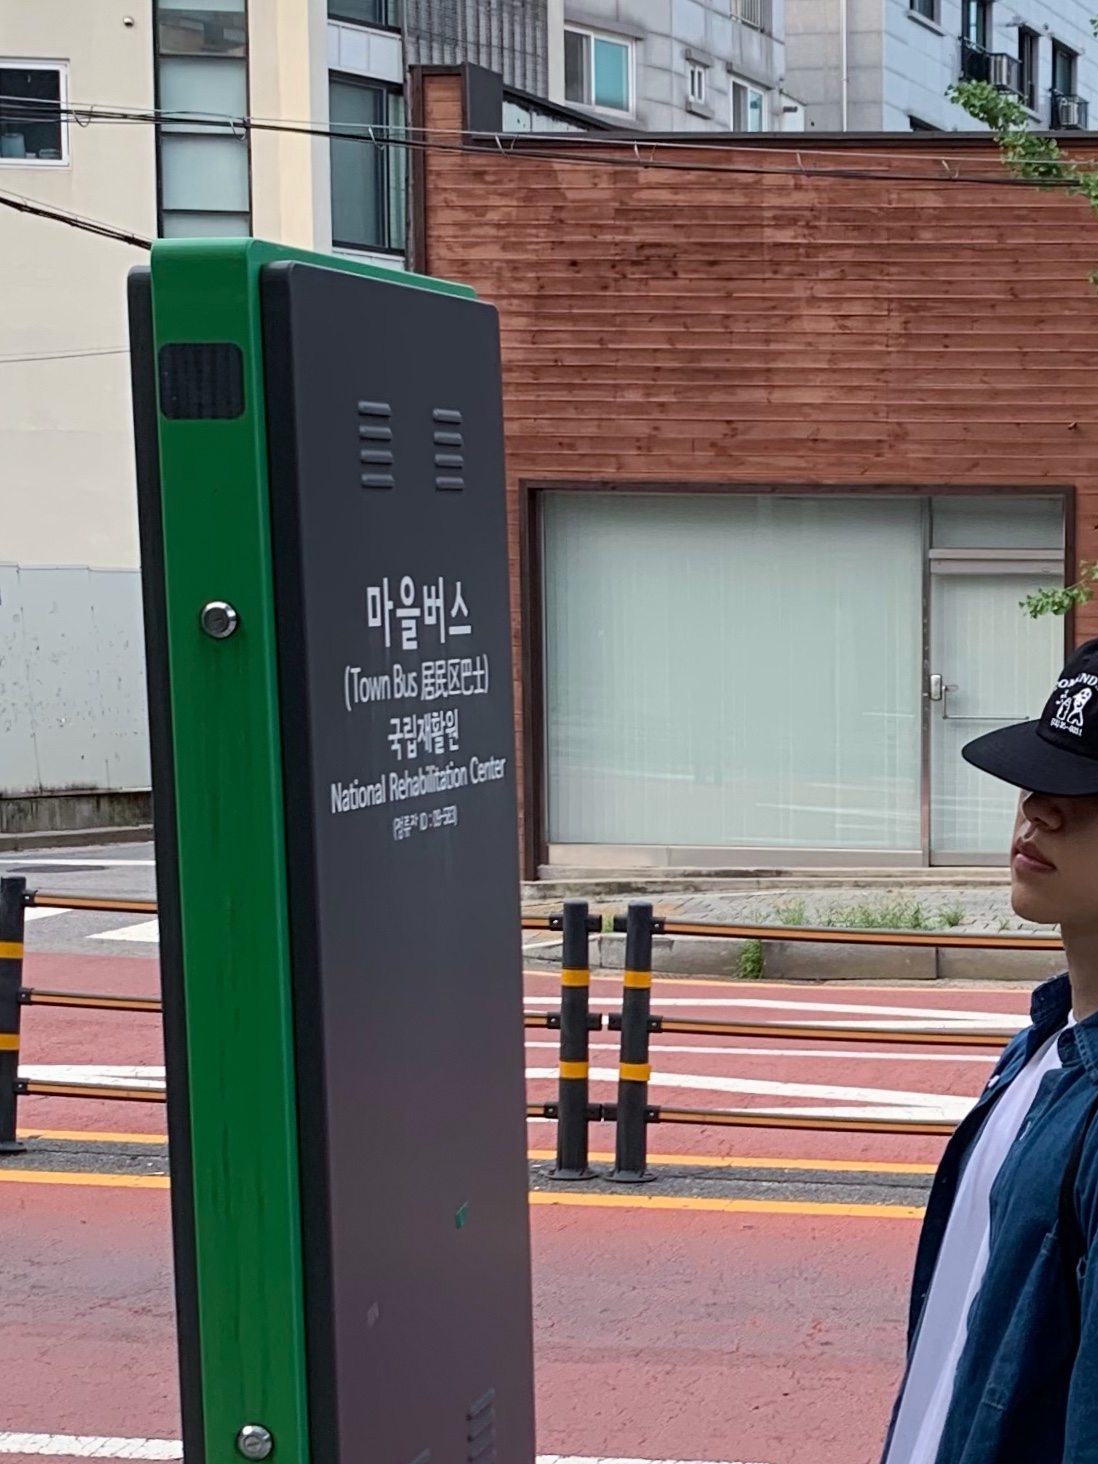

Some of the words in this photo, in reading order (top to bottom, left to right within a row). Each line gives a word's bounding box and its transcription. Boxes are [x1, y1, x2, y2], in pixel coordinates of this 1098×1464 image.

[366, 575, 472, 650] 마을버스
[344, 665, 391, 711] (Town
[393, 663, 418, 699] Bus
[387, 708, 459, 761] 국립재활원
[330, 774, 386, 814] National
[388, 761, 468, 802] Rehabilitation
[469, 755, 507, 784] Center
